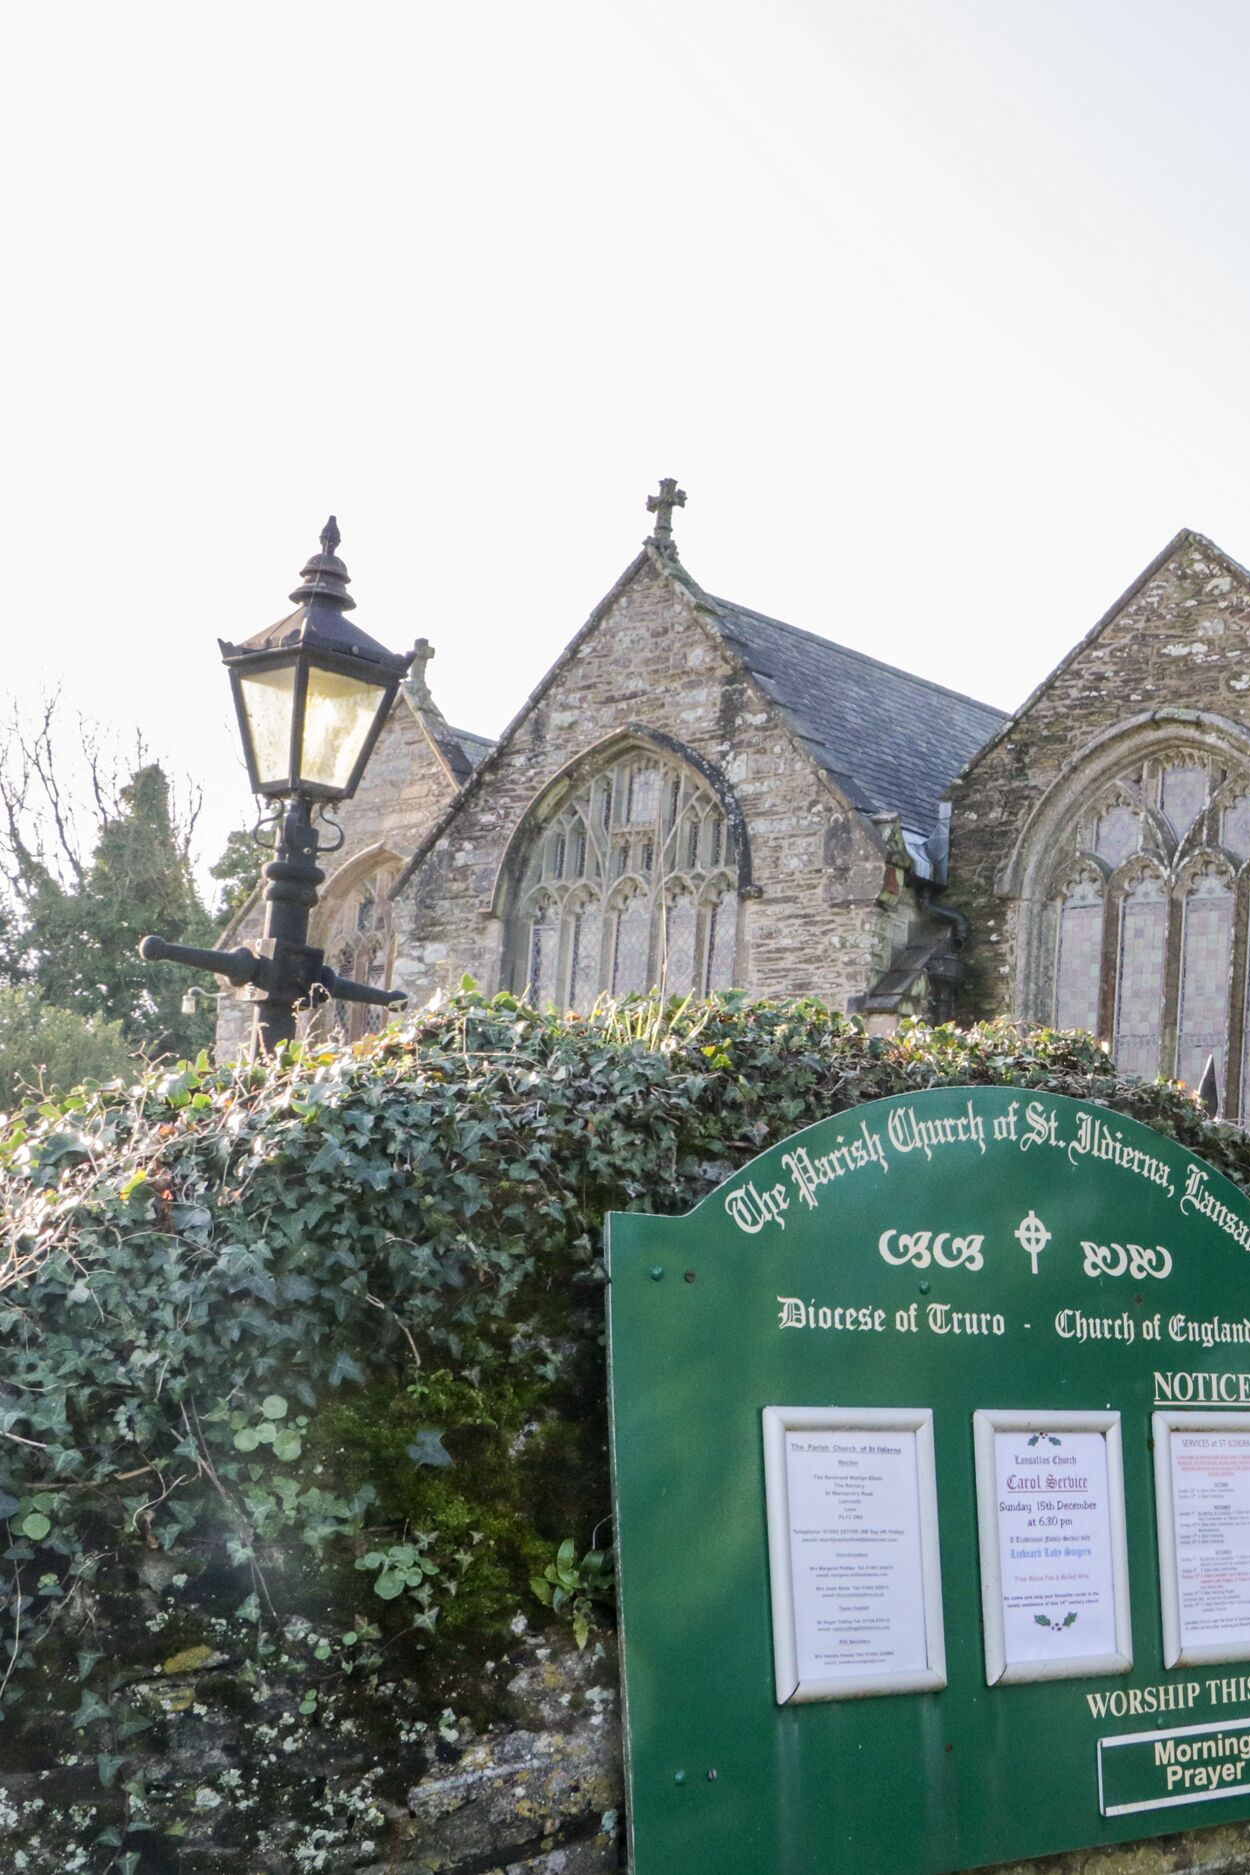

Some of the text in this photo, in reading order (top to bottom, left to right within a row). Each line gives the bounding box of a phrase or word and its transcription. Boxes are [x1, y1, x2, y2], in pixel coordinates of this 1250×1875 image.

[725, 1181, 790, 1234] The
[782, 1120, 889, 1211] Parish
[888, 1100, 986, 1162] Church
[993, 1101, 1020, 1141] of
[1020, 1101, 1066, 1151] St.
[776, 1295, 887, 1332] Diocese
[895, 1302, 919, 1333] of
[926, 1302, 1006, 1336] Truro
[1054, 1308, 1135, 1345] Church
[1142, 1313, 1162, 1341] of
[1181, 1439, 1210, 1448] SERVICES
[1014, 1455, 1077, 1465] Lansallos Church
[1006, 1473, 1088, 1490] Carol Service
[999, 1500, 1097, 1514] Sunday 15th December
[1027, 1516, 1073, 1529] at 6.30 pm
[1086, 1682, 1200, 1719] WORSHIP
[1166, 1761, 1246, 1790] Prayer
